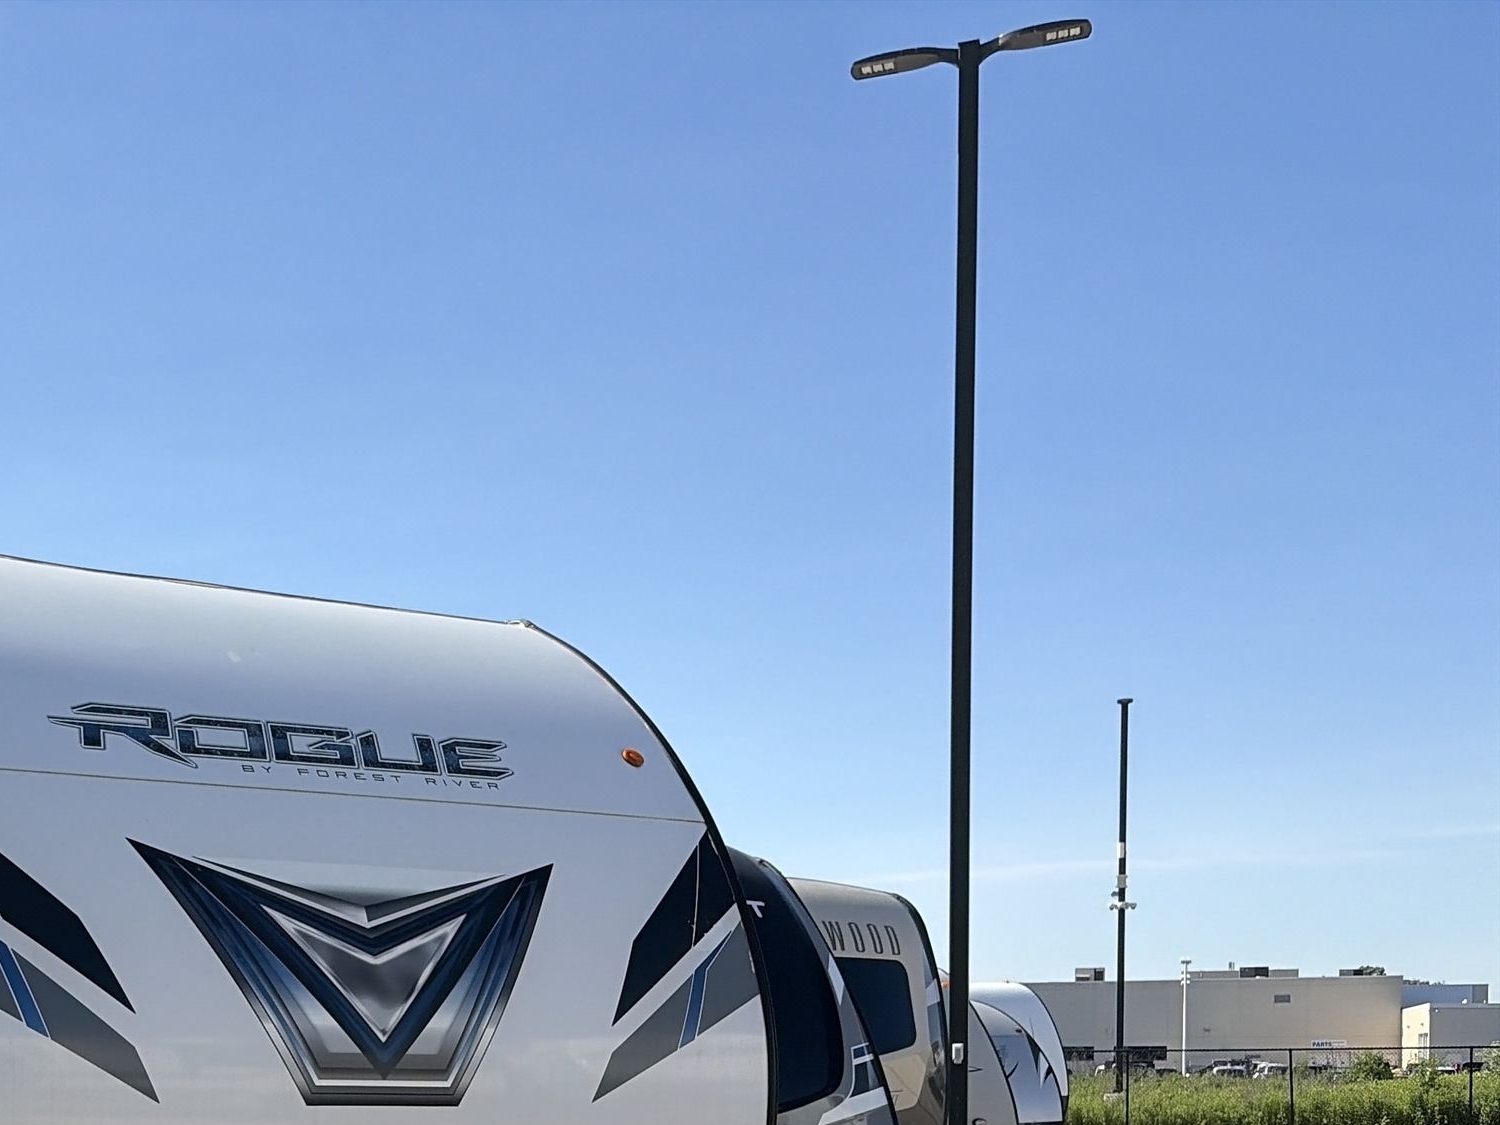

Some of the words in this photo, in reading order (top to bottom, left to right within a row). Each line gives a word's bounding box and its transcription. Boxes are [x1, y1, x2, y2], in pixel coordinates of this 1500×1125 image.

[47, 702, 513, 780] ROGUE
[241, 764, 272, 774] BY
[297, 768, 402, 784] FOREST
[424, 777, 501, 791] RIVER
